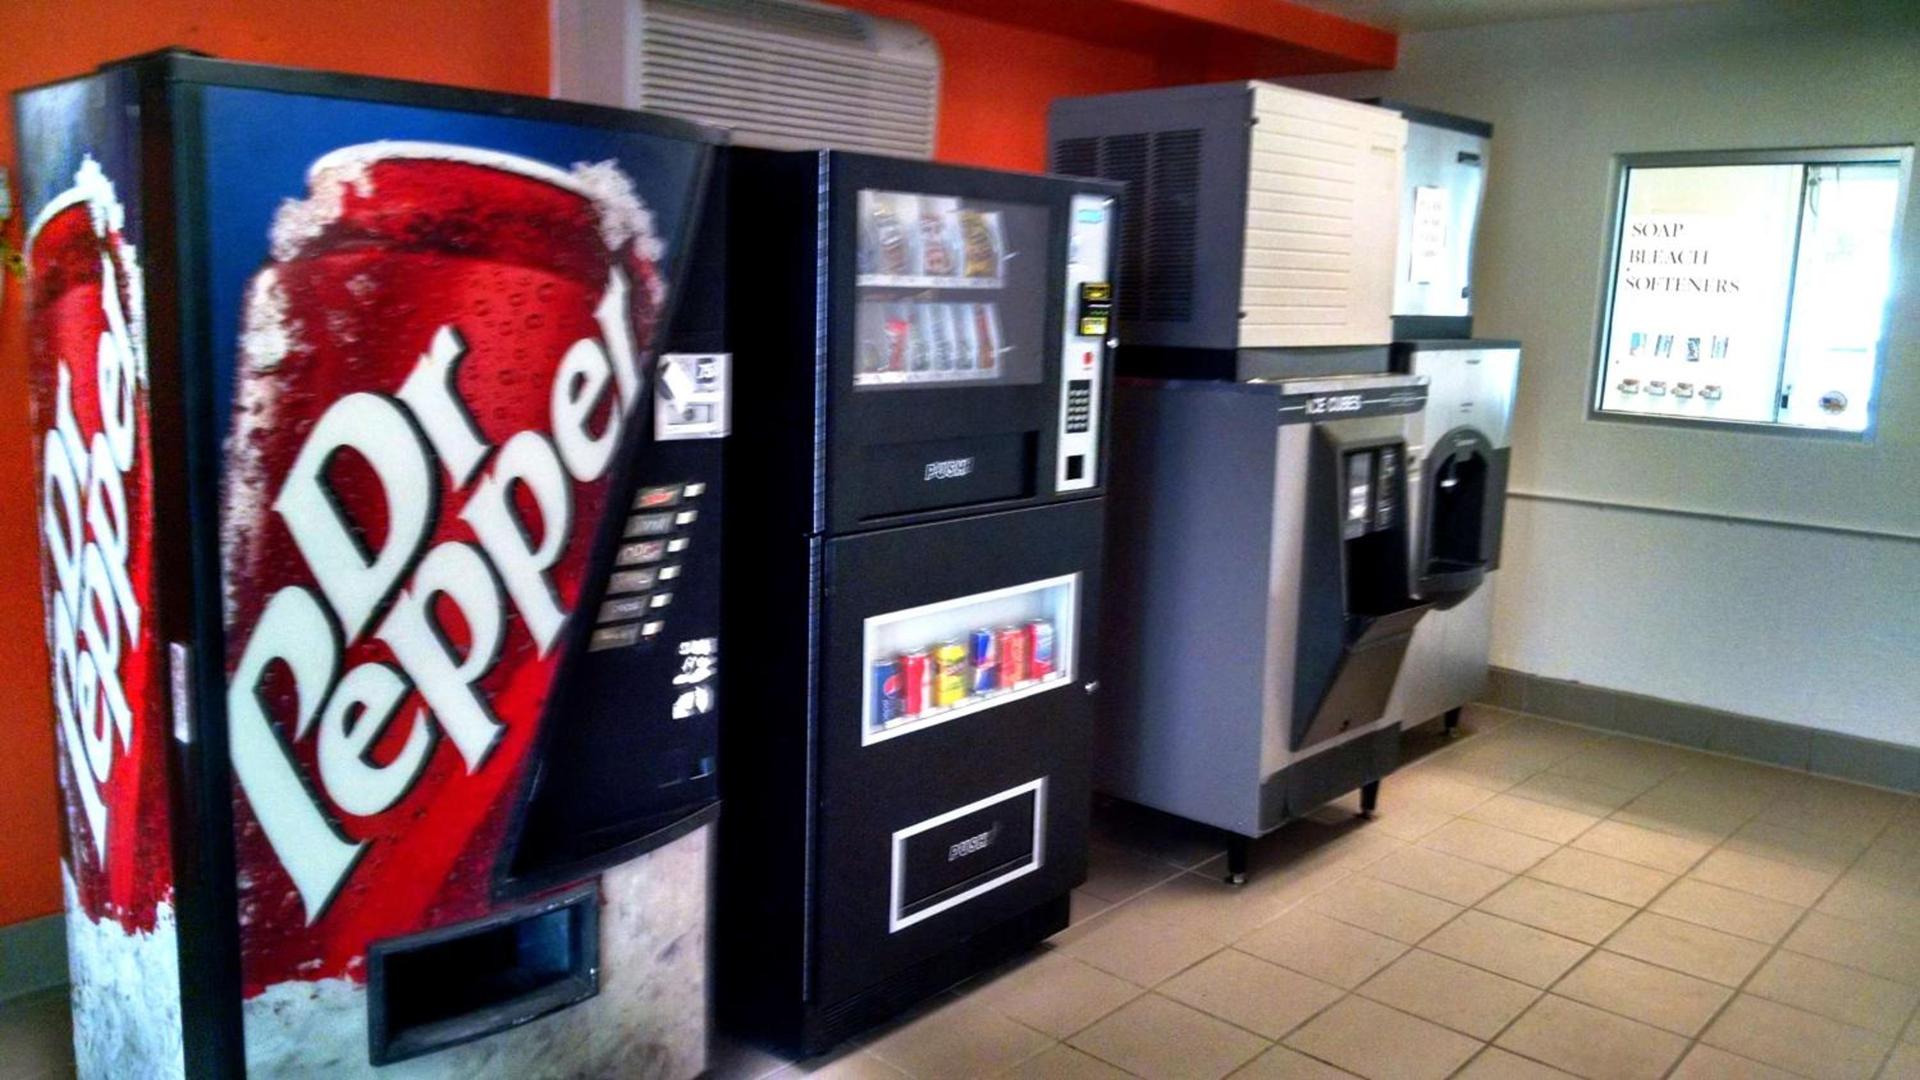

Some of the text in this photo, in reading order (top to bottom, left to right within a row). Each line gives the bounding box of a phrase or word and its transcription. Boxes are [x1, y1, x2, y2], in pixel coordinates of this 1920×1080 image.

[1632, 222, 1684, 238] SOAP
[1629, 249, 1709, 265] BLEACH
[1626, 276, 1740, 293] SOFTENERS
[1305, 395, 1362, 415] ICE CUBES
[924, 457, 974, 480] PUSH
[273, 326, 492, 633] Dr
[44, 358, 91, 630] Dr
[227, 264, 645, 925] Pepper
